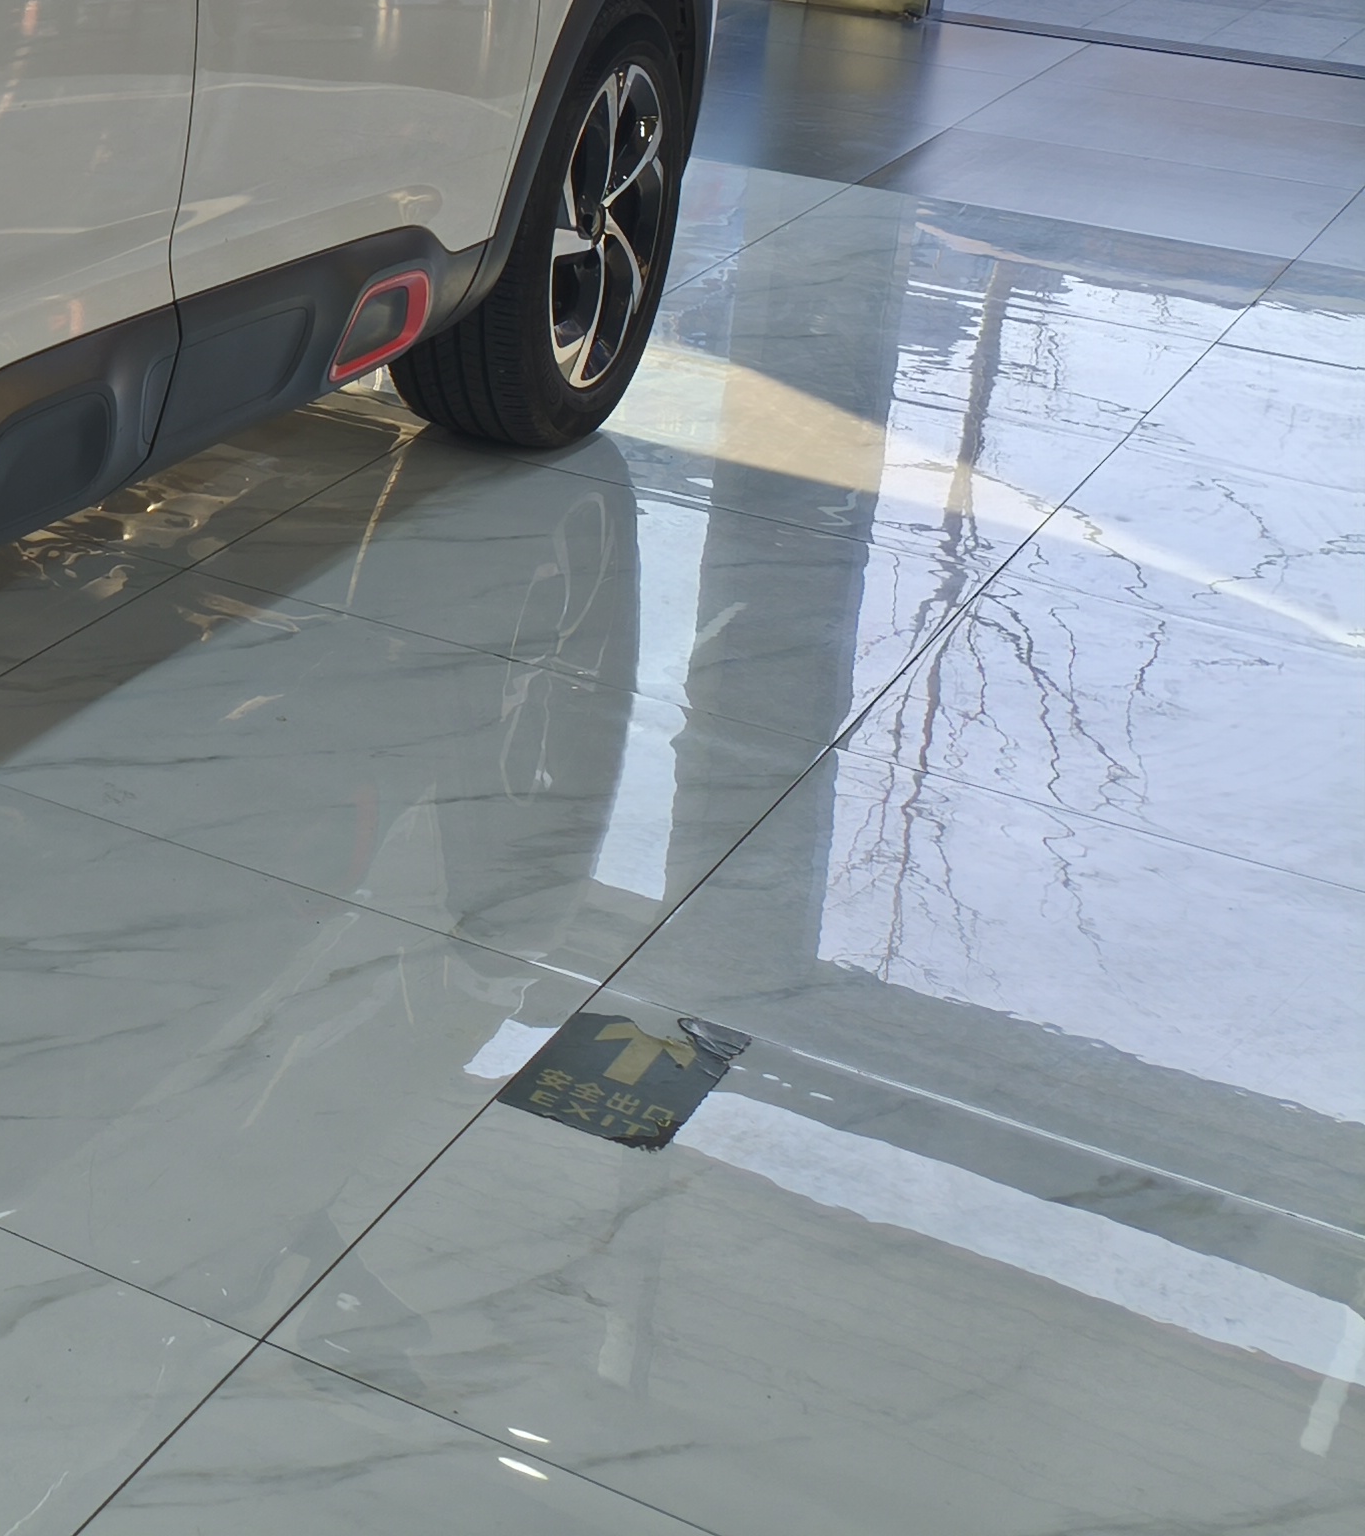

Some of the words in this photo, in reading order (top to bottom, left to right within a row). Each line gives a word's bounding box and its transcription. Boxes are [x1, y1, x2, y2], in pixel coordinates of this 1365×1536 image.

[529, 1089, 655, 1138] EXIT
[535, 1068, 676, 1129] 安全出口
